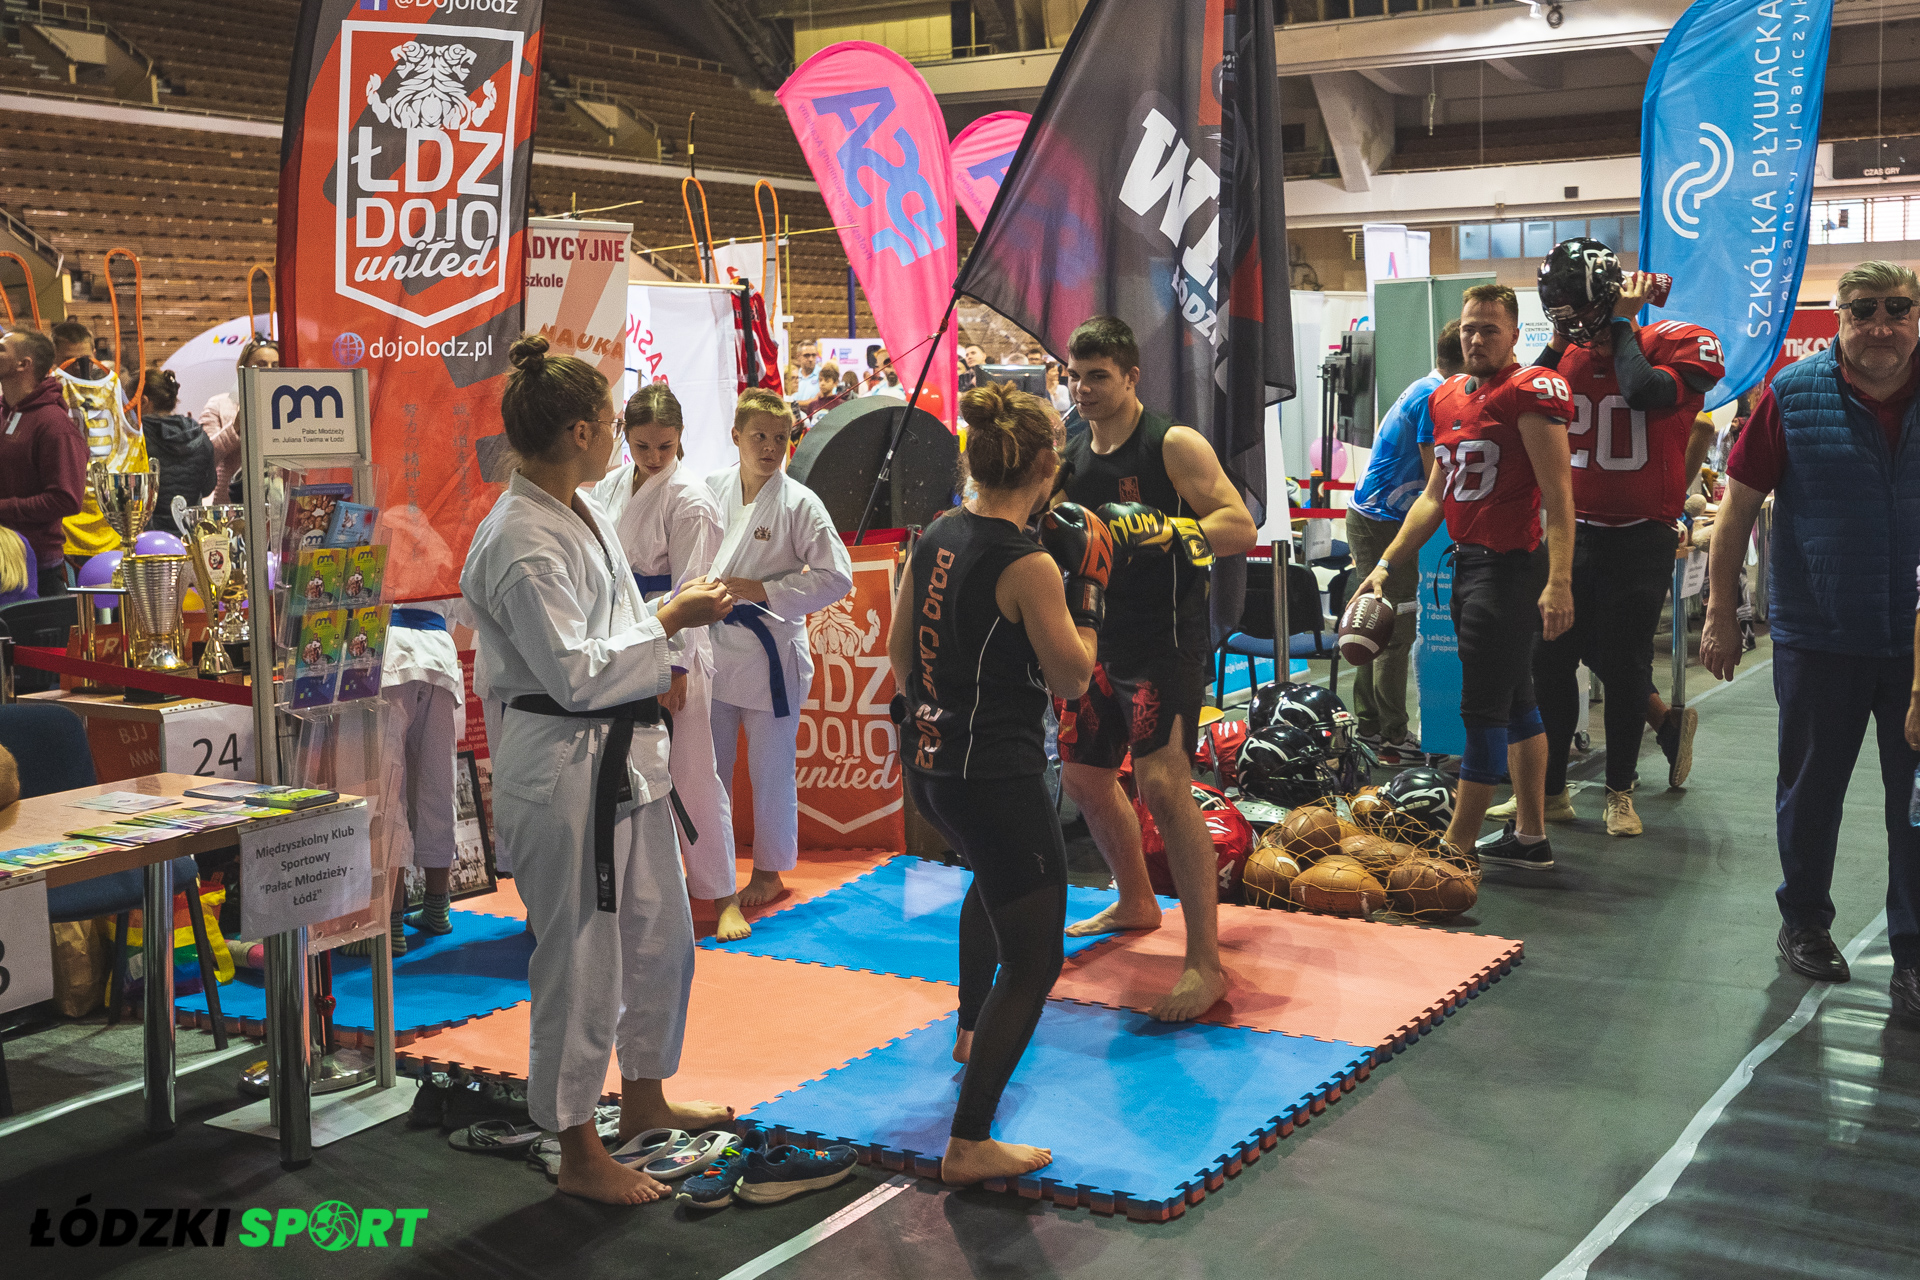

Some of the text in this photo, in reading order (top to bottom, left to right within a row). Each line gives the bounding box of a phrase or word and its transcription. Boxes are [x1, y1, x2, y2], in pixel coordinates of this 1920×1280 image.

[351, 126, 504, 197] ŁDZ
[1746, 0, 1783, 339] SZKÓŁKA PŁYWACKA
[1862, 167, 1901, 177] CZAS GRY
[355, 197, 499, 250] DOJO
[354, 235, 497, 283] united
[369, 334, 493, 362] dojolodz.pl
[1532, 377, 1570, 402] 98
[1570, 394, 1648, 470] 20
[915, 547, 956, 770] DOJO CAMP 2022
[800, 653, 893, 715] DZ
[118, 724, 148, 745] BJJ
[192, 733, 243, 777] 24
[255, 826, 355, 859] Międzyszkolny Klub
[280, 852, 331, 872] Sportowy
[295, 865, 348, 887] Młodzieży
